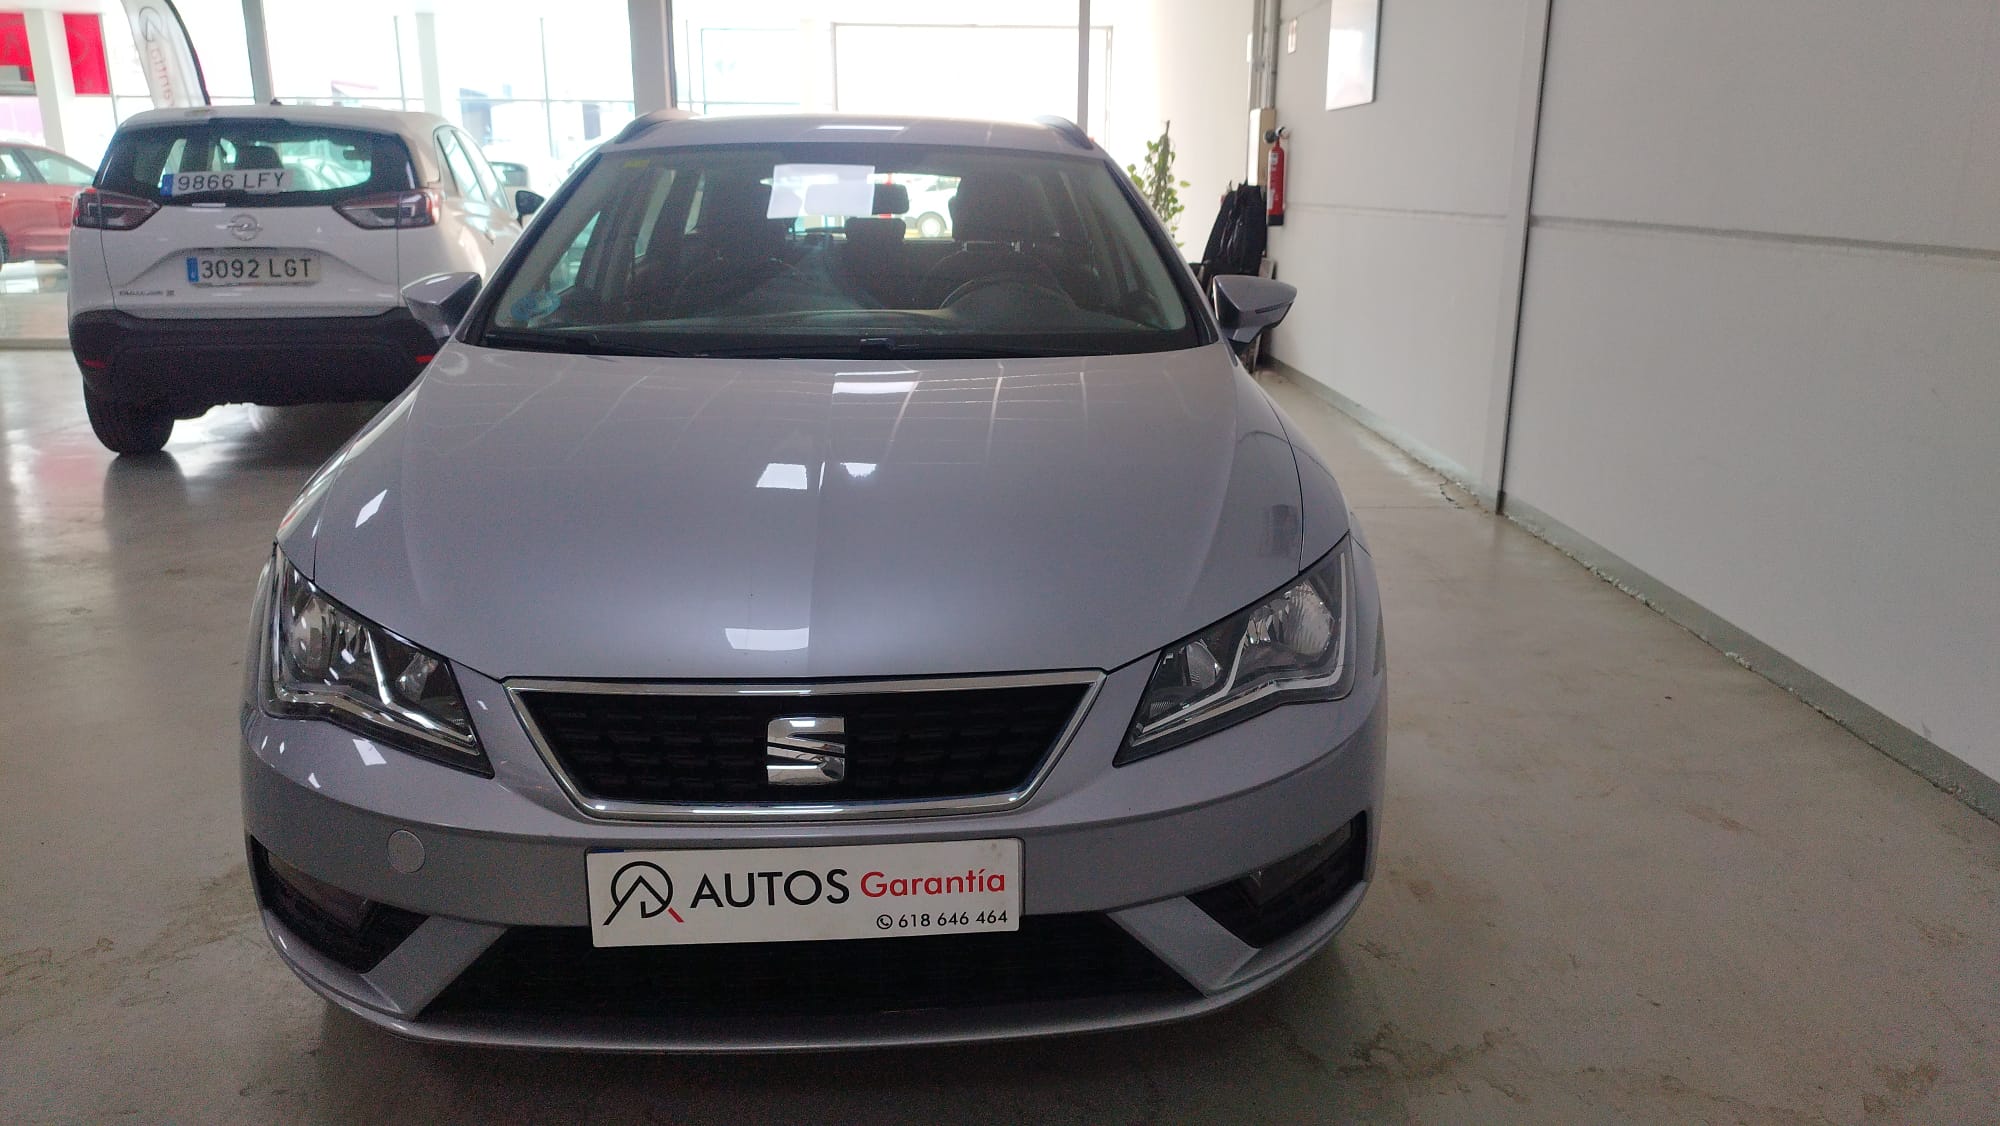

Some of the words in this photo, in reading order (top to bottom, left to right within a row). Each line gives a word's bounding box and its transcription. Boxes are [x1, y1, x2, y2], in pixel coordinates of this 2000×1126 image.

[178, 174, 235, 191] 9866
[243, 172, 285, 188] LFY
[201, 259, 260, 279] 3092
[268, 258, 312, 278] LGT
[690, 868, 850, 908] AUTOS
[860, 868, 1006, 898] Garantía
[898, 914, 931, 929] 618
[937, 911, 970, 927] 646
[975, 910, 1008, 925] 464
